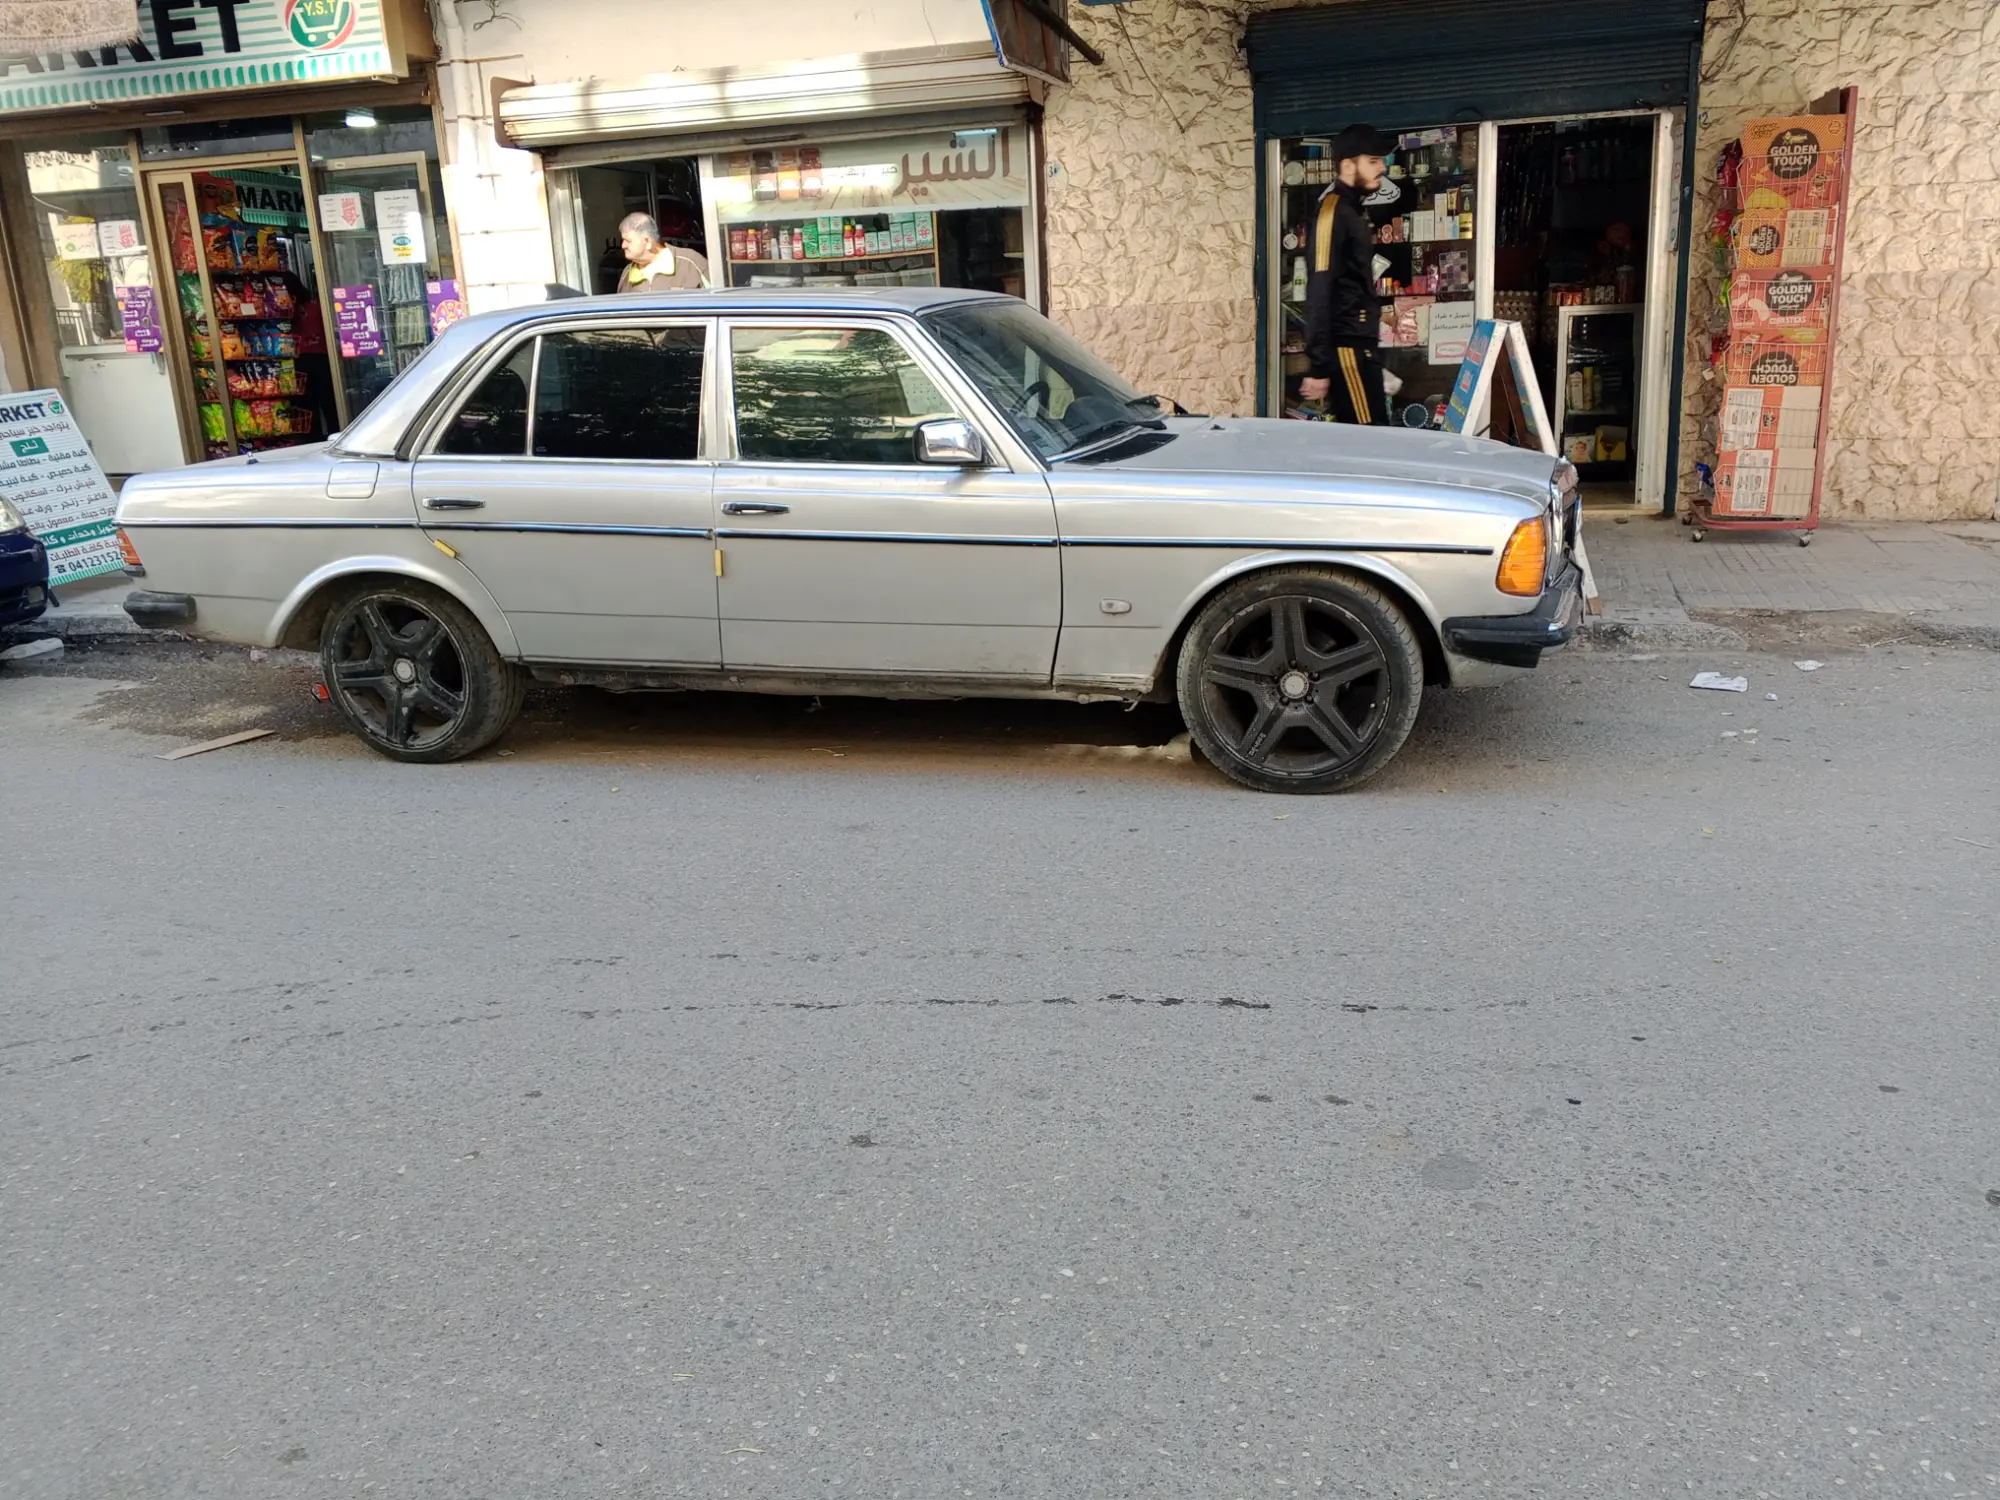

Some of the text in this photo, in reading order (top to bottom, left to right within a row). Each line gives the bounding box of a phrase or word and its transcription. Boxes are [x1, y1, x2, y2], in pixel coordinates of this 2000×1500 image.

[303, 0, 336, 16] Y.S.T
[1770, 144, 1817, 156] GOLDEN
[1773, 155, 1812, 166] TOUCH
[1768, 284, 1812, 295] GOLDEN
[1772, 294, 1808, 305] TOUCH
[1756, 364, 1794, 374] TOUCH
[1751, 374, 1797, 384] GOLDEN
[26, 425, 41, 437] خبز
[42, 420, 70, 432] يتواجد
